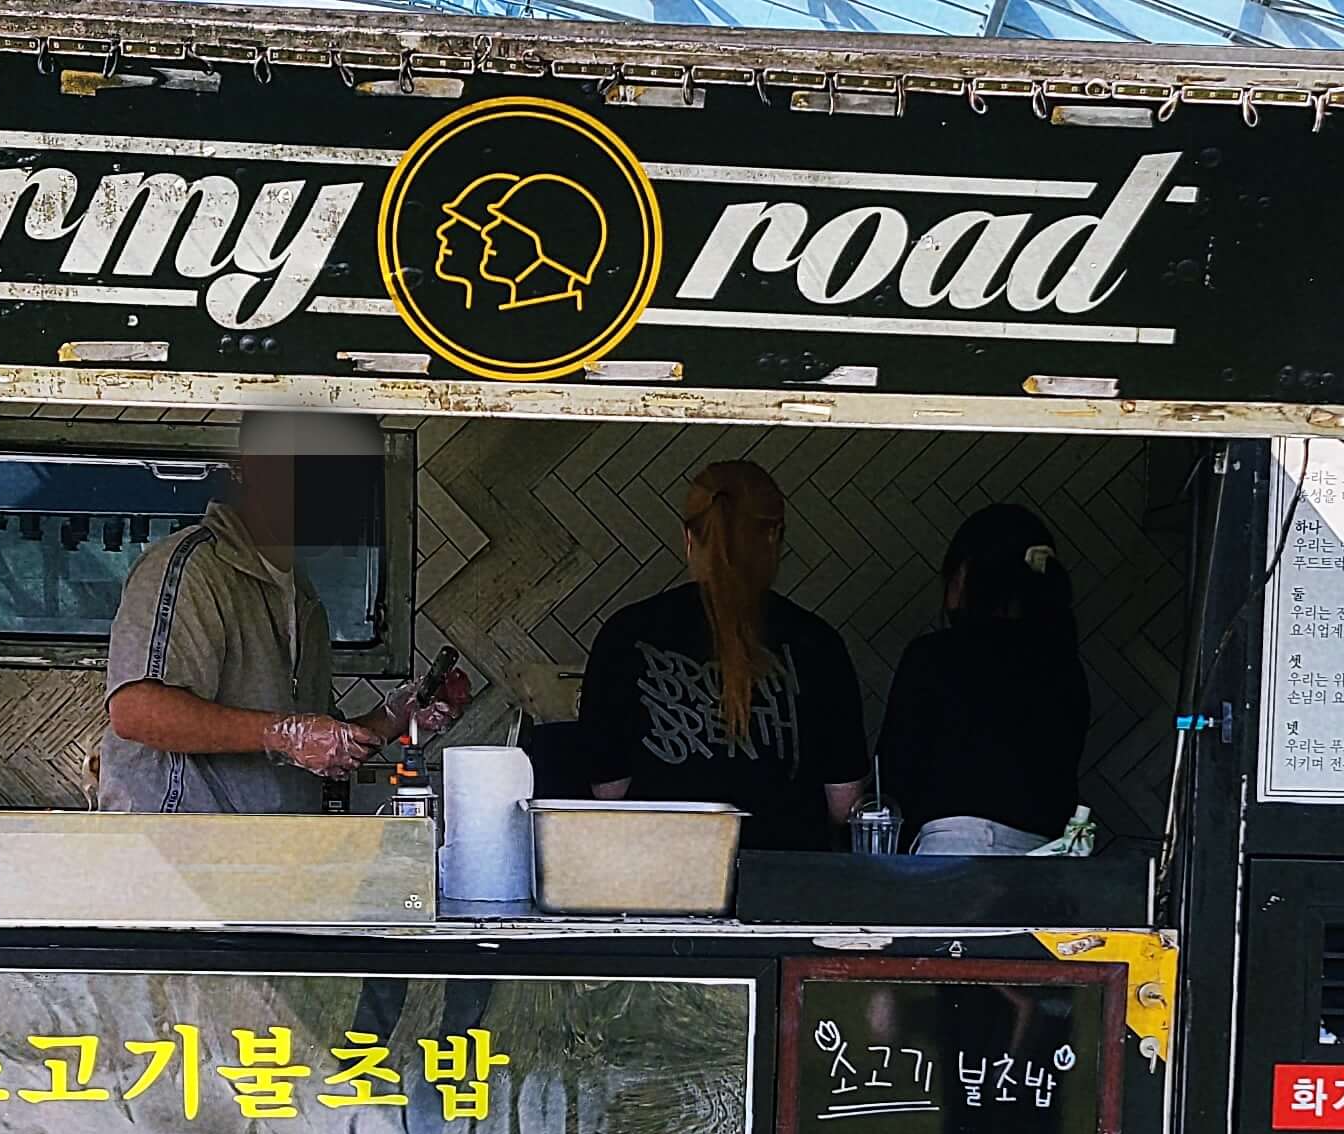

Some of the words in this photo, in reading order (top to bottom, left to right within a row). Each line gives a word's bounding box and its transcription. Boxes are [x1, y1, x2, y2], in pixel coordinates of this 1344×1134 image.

[673, 150, 1184, 314] road
[1295, 520, 1322, 535] 하나
[1293, 537, 1336, 553] 우리는
[1291, 587, 1305, 602] 둘
[1290, 605, 1332, 621] 우리는
[1289, 654, 1302, 669] 셋
[1288, 672, 1329, 688] 우리는
[1288, 690, 1327, 705] 손님의
[1287, 720, 1299, 736] 넷
[1285, 739, 1327, 755] 우리는
[1284, 757, 1324, 772] 지키며
[829, 1041, 934, 1094] 소고기
[958, 1050, 1057, 1108] 불초밥
